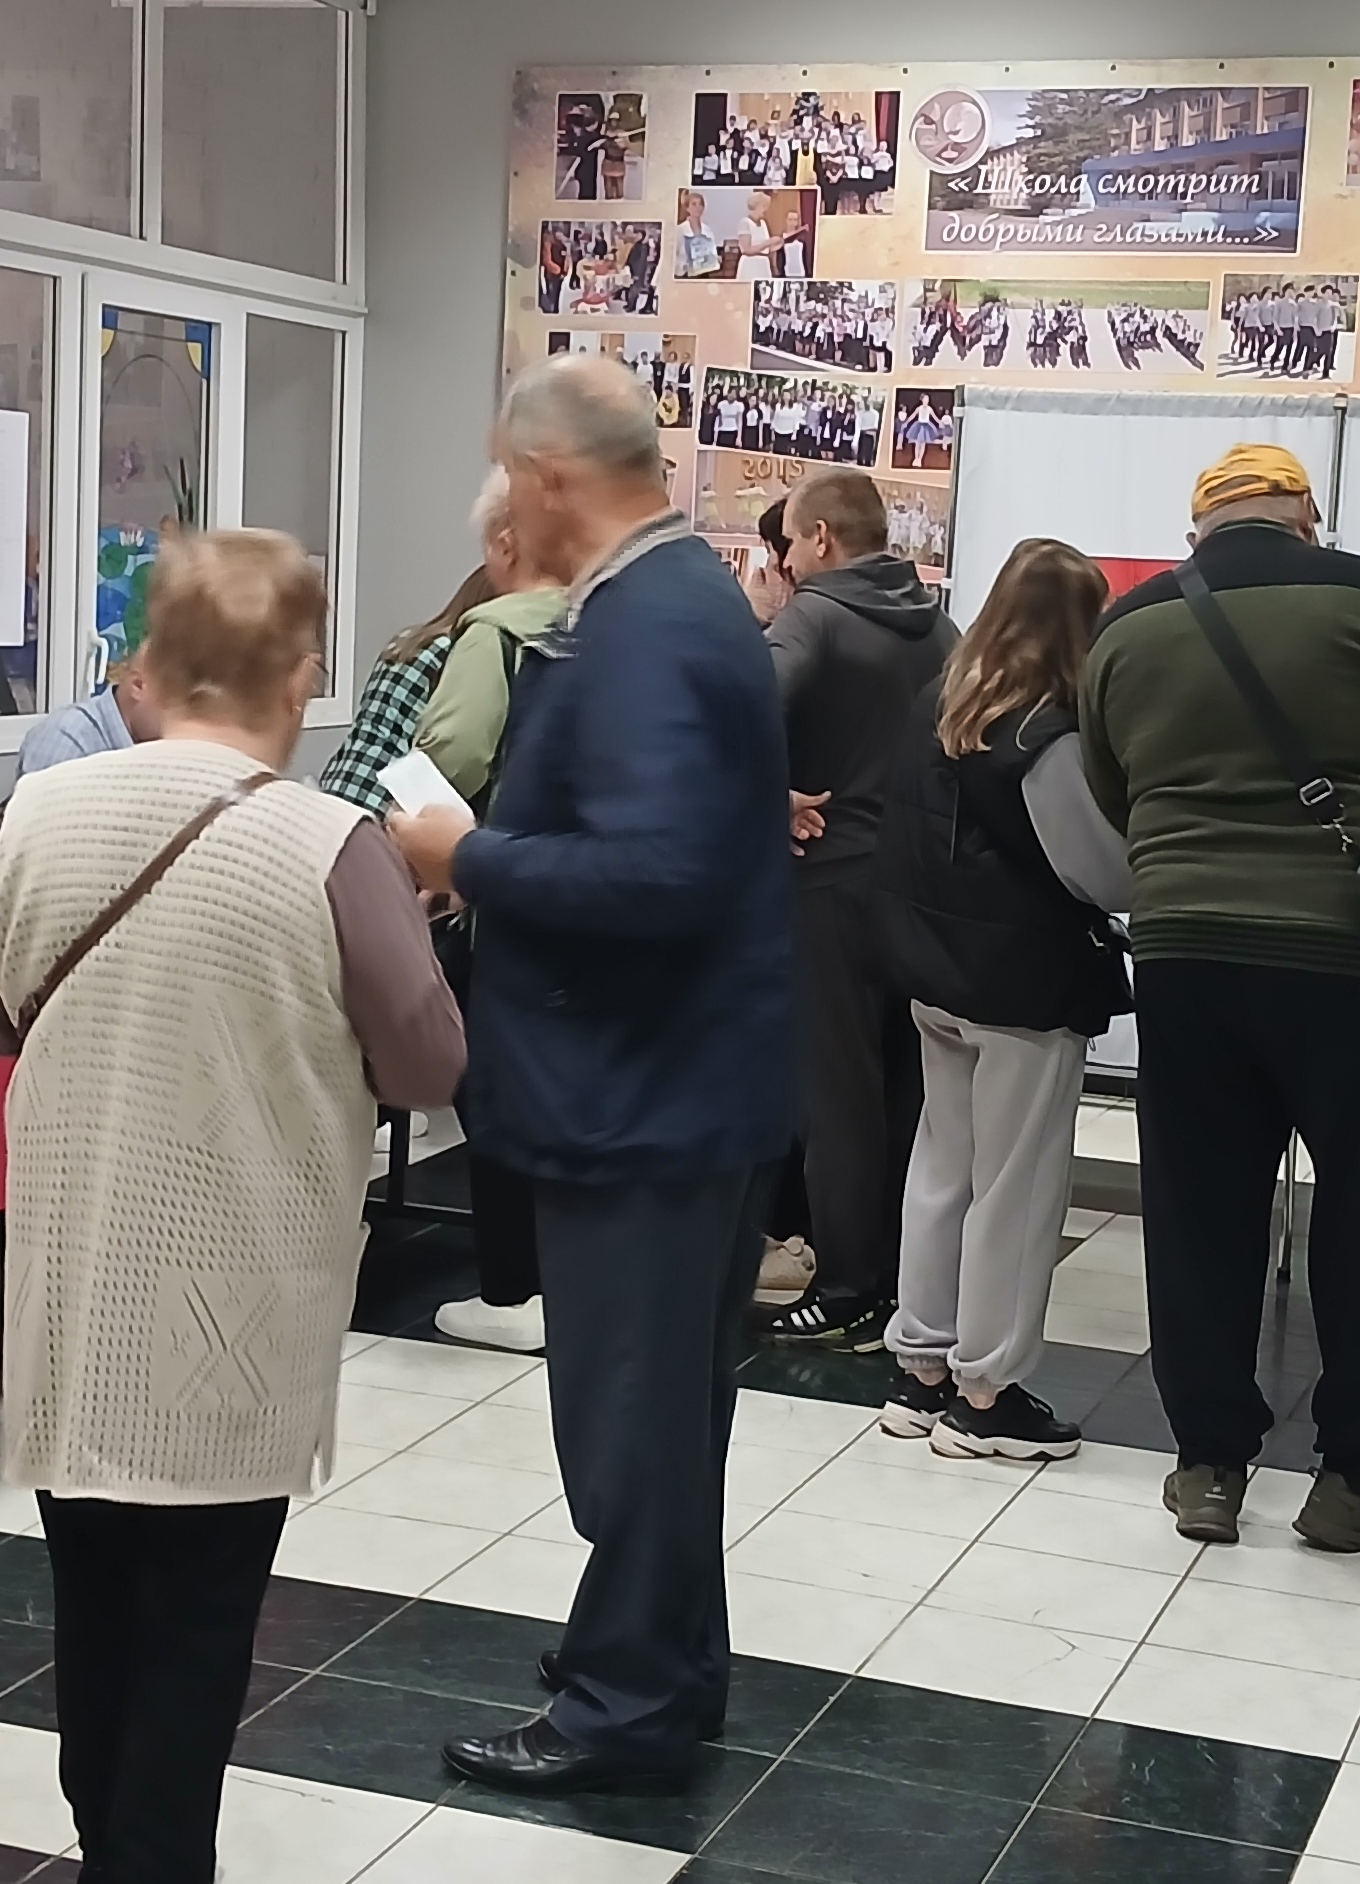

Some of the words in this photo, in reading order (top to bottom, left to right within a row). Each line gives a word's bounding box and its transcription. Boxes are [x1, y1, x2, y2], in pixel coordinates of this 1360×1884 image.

[948, 165, 1089, 194] «Школа
[1098, 174, 1260, 204] смотрит
[943, 213, 1083, 249] добрыми
[1093, 223, 1280, 244] глазами...»
